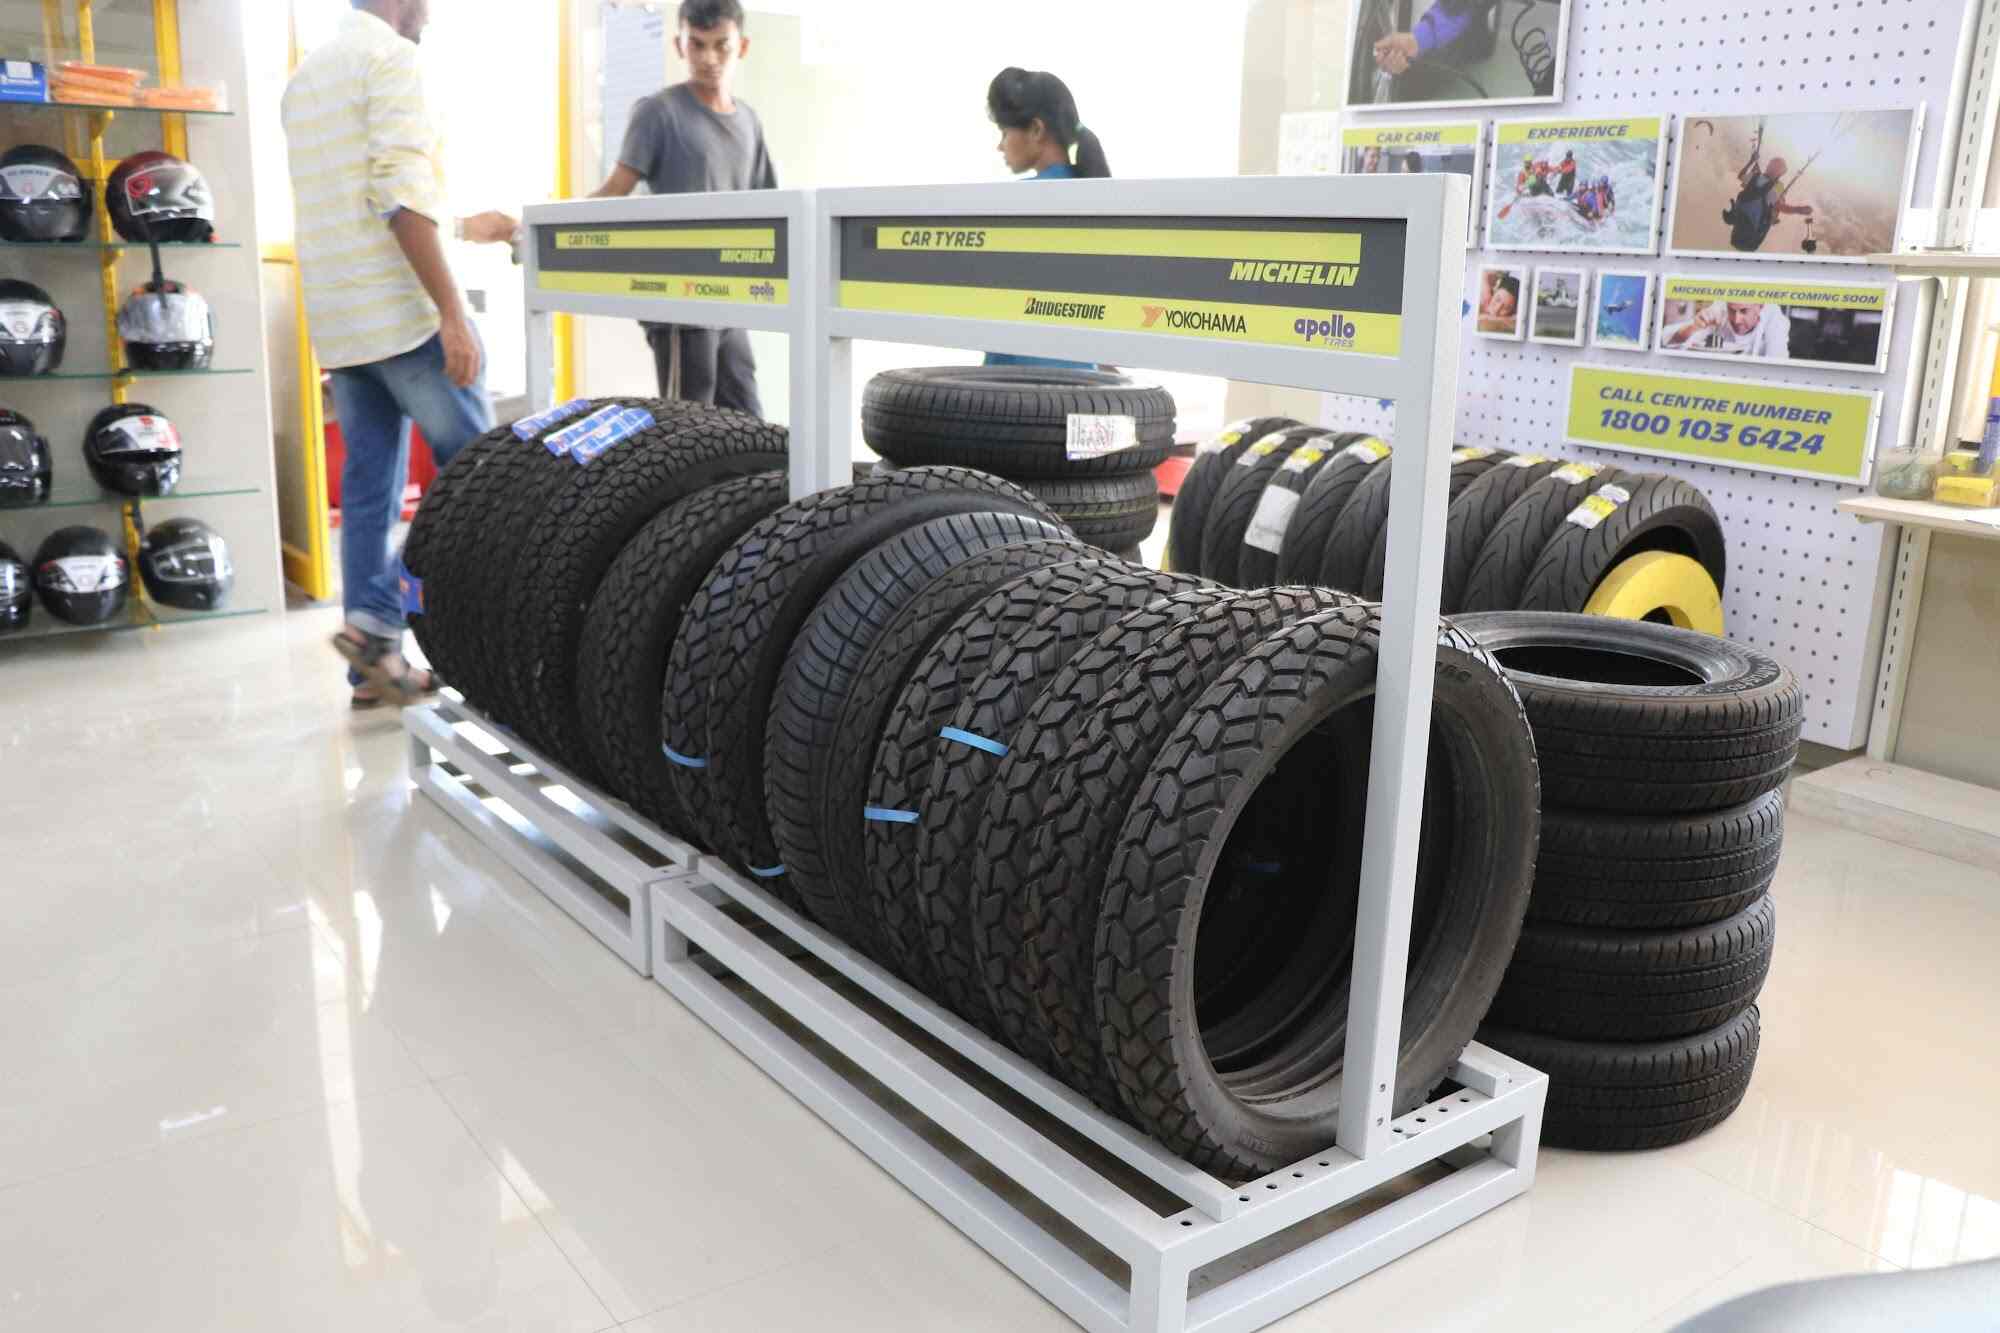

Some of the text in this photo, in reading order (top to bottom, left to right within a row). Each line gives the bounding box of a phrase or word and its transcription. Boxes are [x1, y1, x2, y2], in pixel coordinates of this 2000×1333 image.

[1376, 131, 1441, 143] CAR CARE
[1527, 125, 1629, 140] EXPERIENCE
[568, 234, 584, 246] CAR
[901, 231, 986, 248] CAR TYRES
[720, 249, 775, 264] MICHELIN
[1229, 262, 1360, 287] MICHELIN
[1672, 285, 1879, 304] MICHELIN STAR CHEF COMING SOON
[1024, 297, 1106, 320] BRIDGESTONE
[1165, 309, 1247, 334] YOKOHAMA
[1294, 314, 1356, 342] apollo
[1599, 386, 1832, 425] CALL CENTRE NUMBER
[1600, 408, 1825, 455] 1800 103 6424
